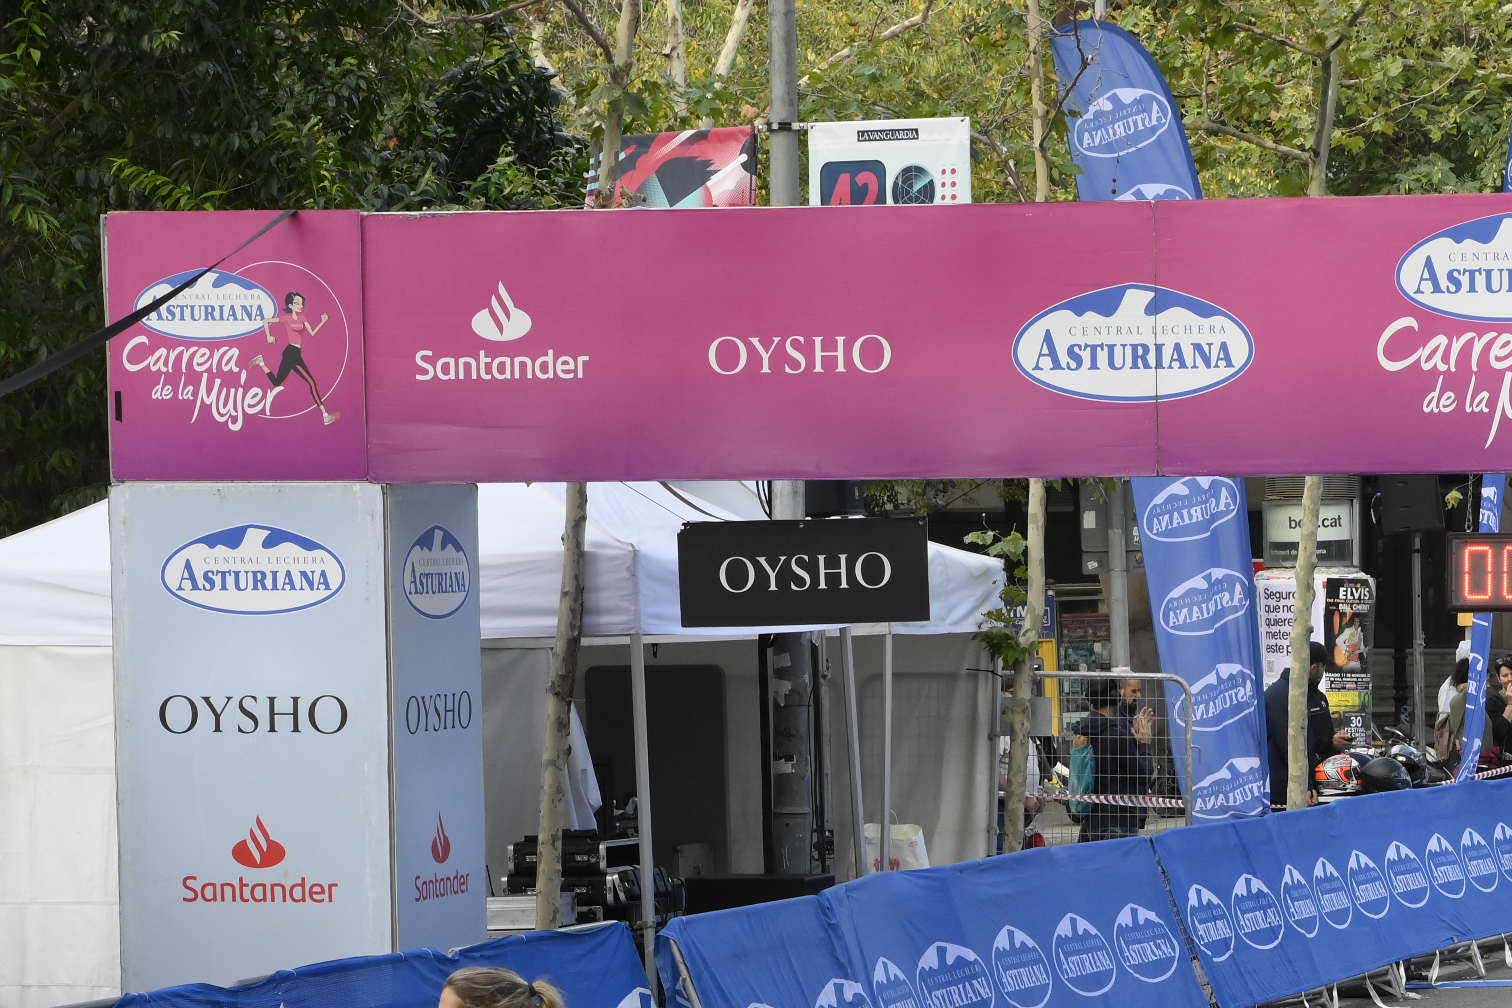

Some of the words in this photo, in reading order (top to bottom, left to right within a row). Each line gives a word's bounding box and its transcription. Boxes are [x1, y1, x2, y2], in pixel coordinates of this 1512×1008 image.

[869, 128, 918, 141] VANGUARDIA
[1068, 324, 1144, 337] CENTRAL
[1151, 323, 1228, 336] LECHERA
[122, 335, 240, 373] Carrera
[415, 348, 589, 381] Santander
[708, 333, 893, 376] OYSHO
[1031, 328, 1235, 372] ASTURIANA
[152, 374, 173, 400] de
[178, 373, 194, 400] la
[191, 370, 285, 432] Mujer
[1422, 375, 1458, 414] de
[1465, 375, 1489, 414] la
[176, 558, 332, 593] ASTURIANA
[408, 562, 467, 597] ASTURIANA
[718, 551, 892, 593] OYSHO
[1264, 604, 1283, 615] que
[1339, 586, 1370, 600] ELVIS
[1265, 644, 1286, 654] este
[158, 694, 349, 736] OYSHO
[406, 690, 473, 736] OYSHO
[1350, 716, 1363, 727] 30
[182, 875, 339, 904] Santander
[414, 871, 470, 904] Santander
